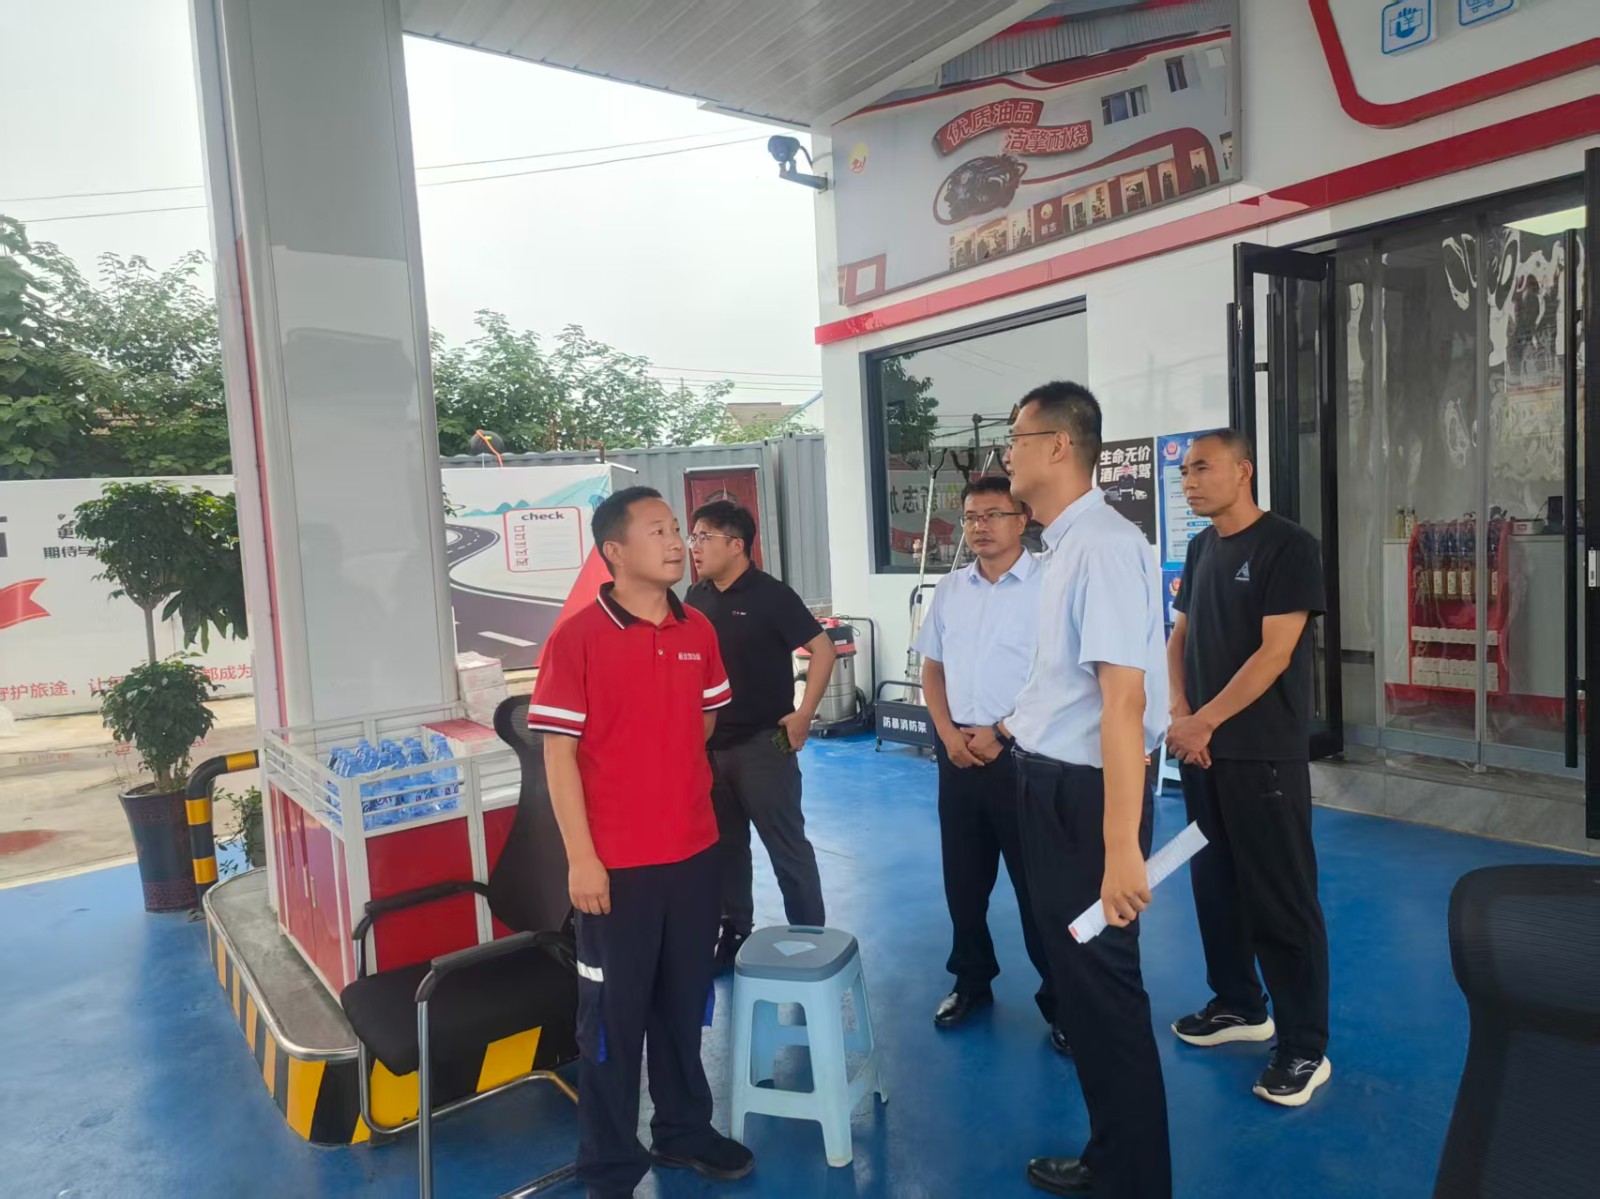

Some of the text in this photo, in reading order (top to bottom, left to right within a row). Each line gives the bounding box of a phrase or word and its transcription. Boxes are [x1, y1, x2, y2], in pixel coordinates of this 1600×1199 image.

[946, 101, 1034, 146] 优质油品
[1004, 124, 1088, 152] 洁擎耐烧
[1100, 445, 1151, 465] 生命无价
[521, 511, 564, 520] check
